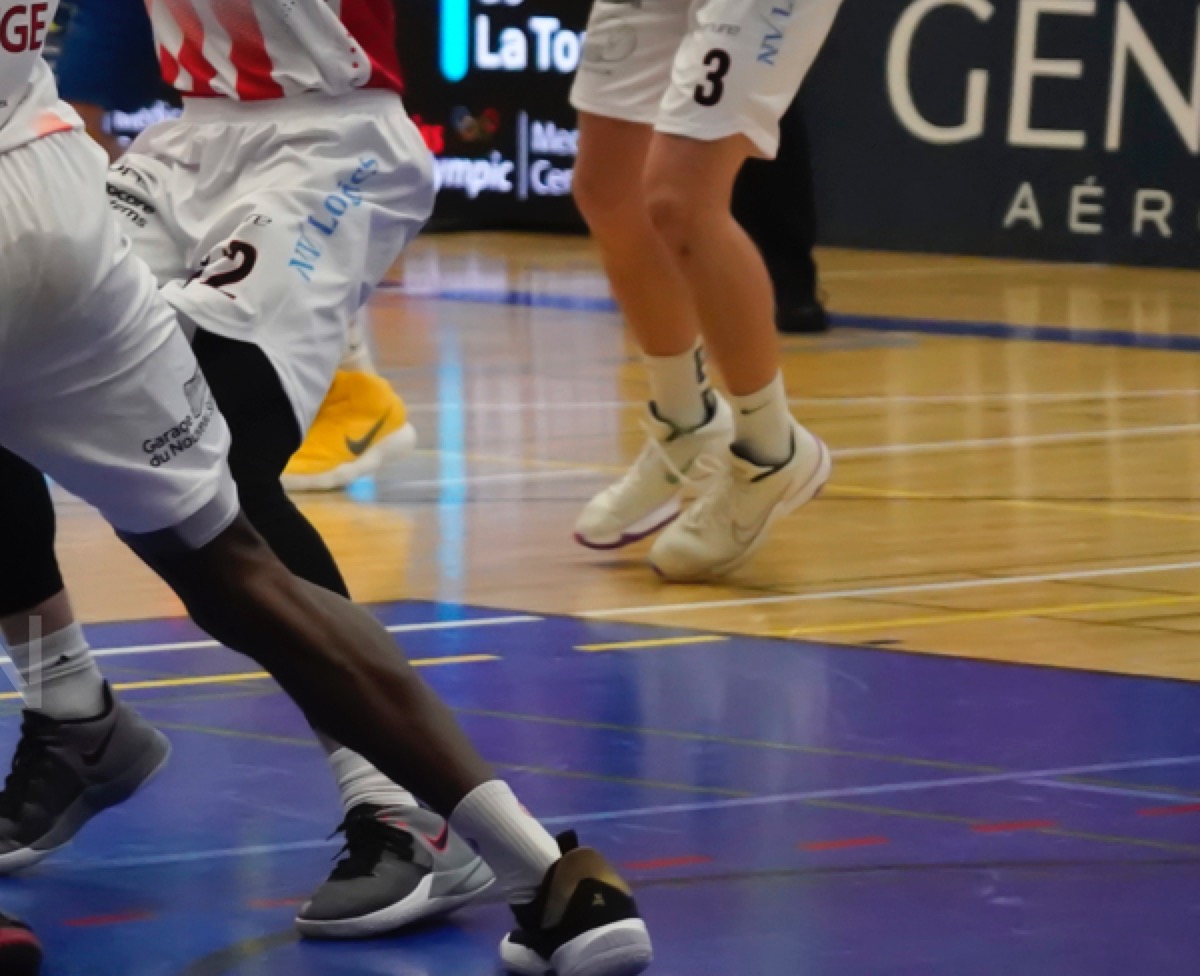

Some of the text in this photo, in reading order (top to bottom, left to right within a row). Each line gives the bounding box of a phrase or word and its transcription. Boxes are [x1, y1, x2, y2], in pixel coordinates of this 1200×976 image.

[474, 13, 587, 74] La To
[693, 47, 731, 107] 3
[1003, 175, 1200, 239] AÉR
